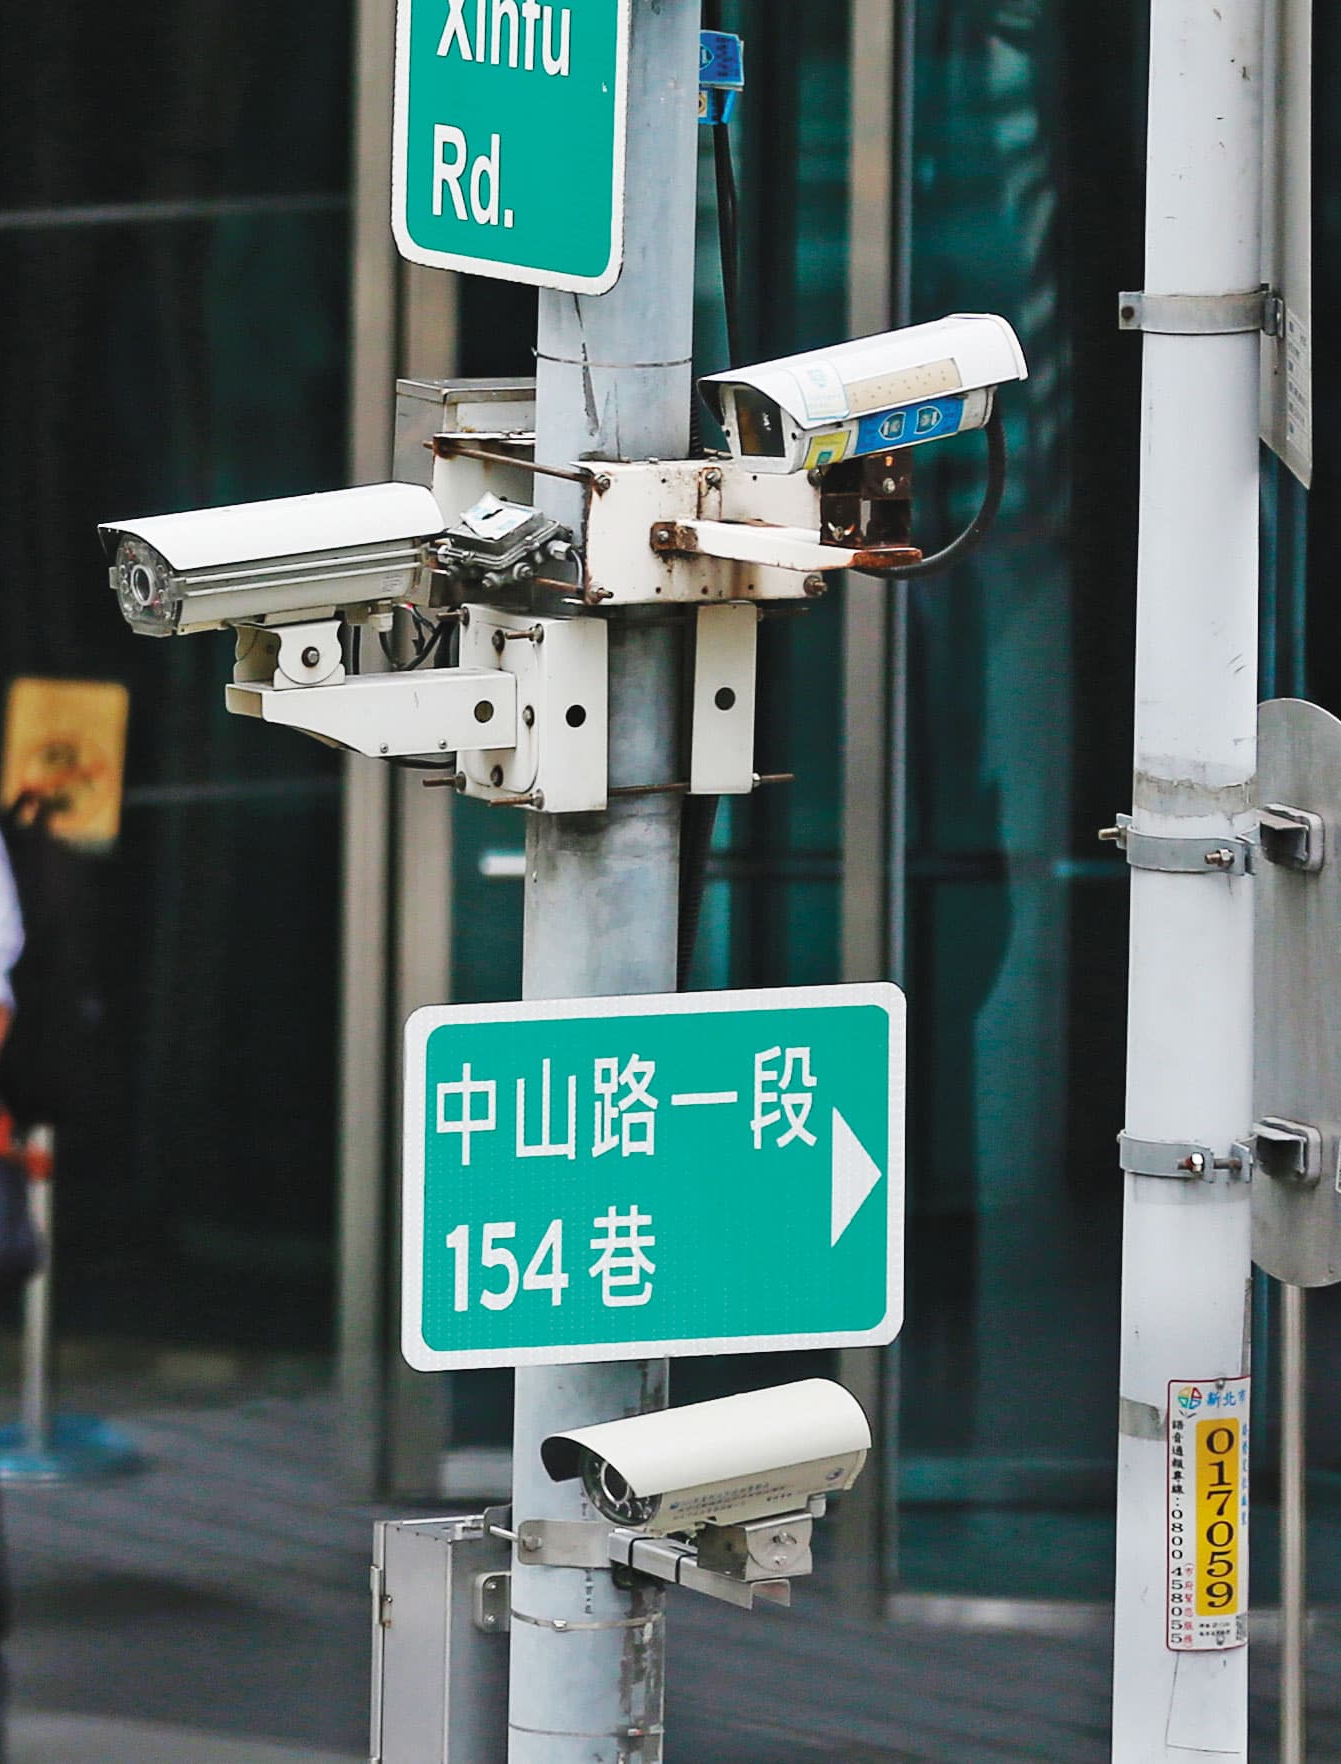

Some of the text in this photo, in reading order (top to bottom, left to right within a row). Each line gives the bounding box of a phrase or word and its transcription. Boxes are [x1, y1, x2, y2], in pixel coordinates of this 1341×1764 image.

[432, 123, 515, 228] Rd.
[436, 1046, 818, 1166] 中山路一段
[445, 1205, 657, 1312] 154巷
[1205, 1427, 1235, 1608] 017059
